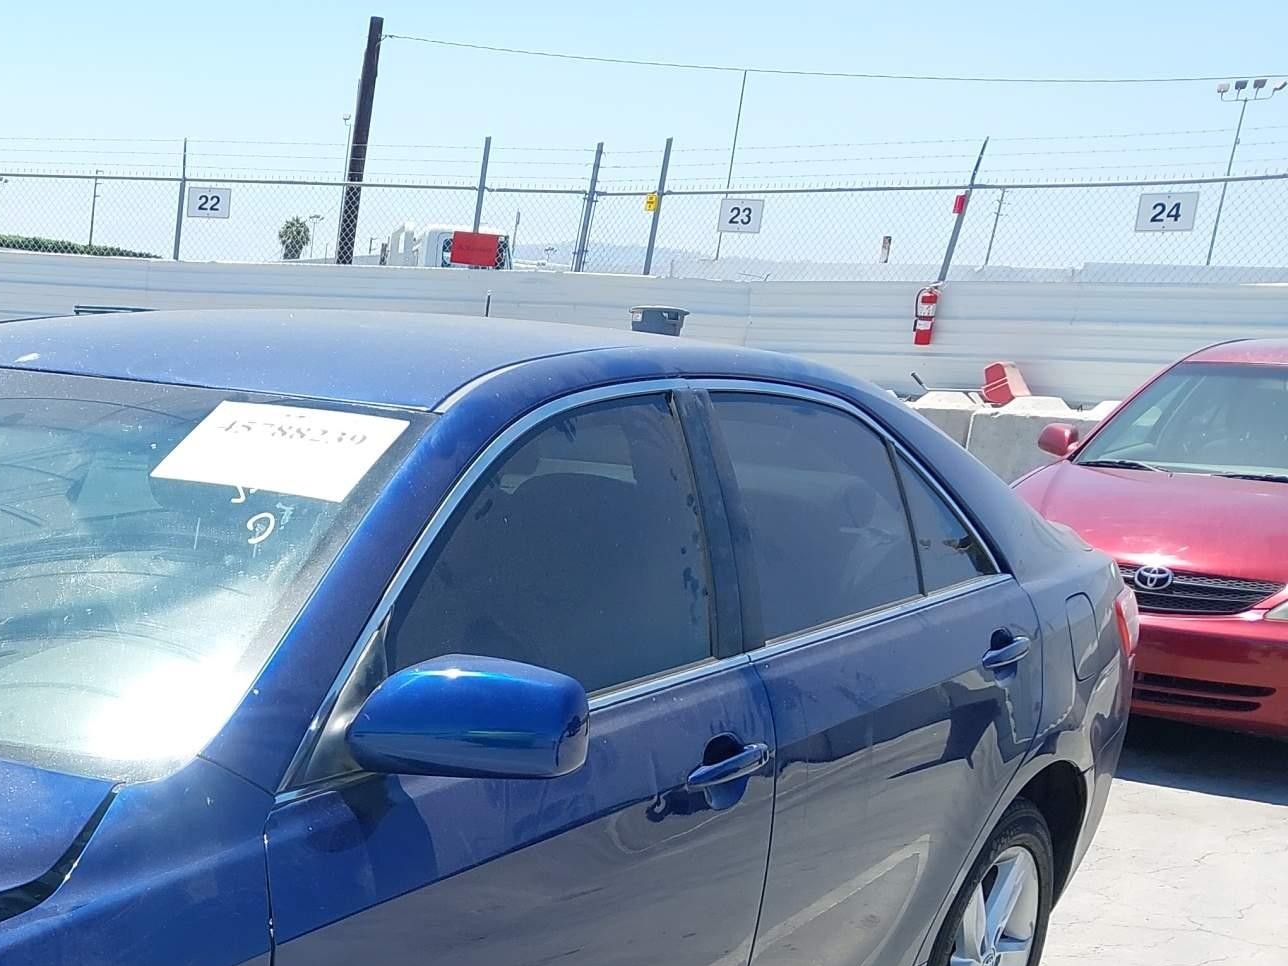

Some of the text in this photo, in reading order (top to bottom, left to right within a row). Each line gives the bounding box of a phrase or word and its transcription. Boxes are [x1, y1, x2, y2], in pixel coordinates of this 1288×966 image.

[198, 194, 221, 211] 22
[728, 206, 753, 225] 23
[1149, 202, 1182, 223] 24
